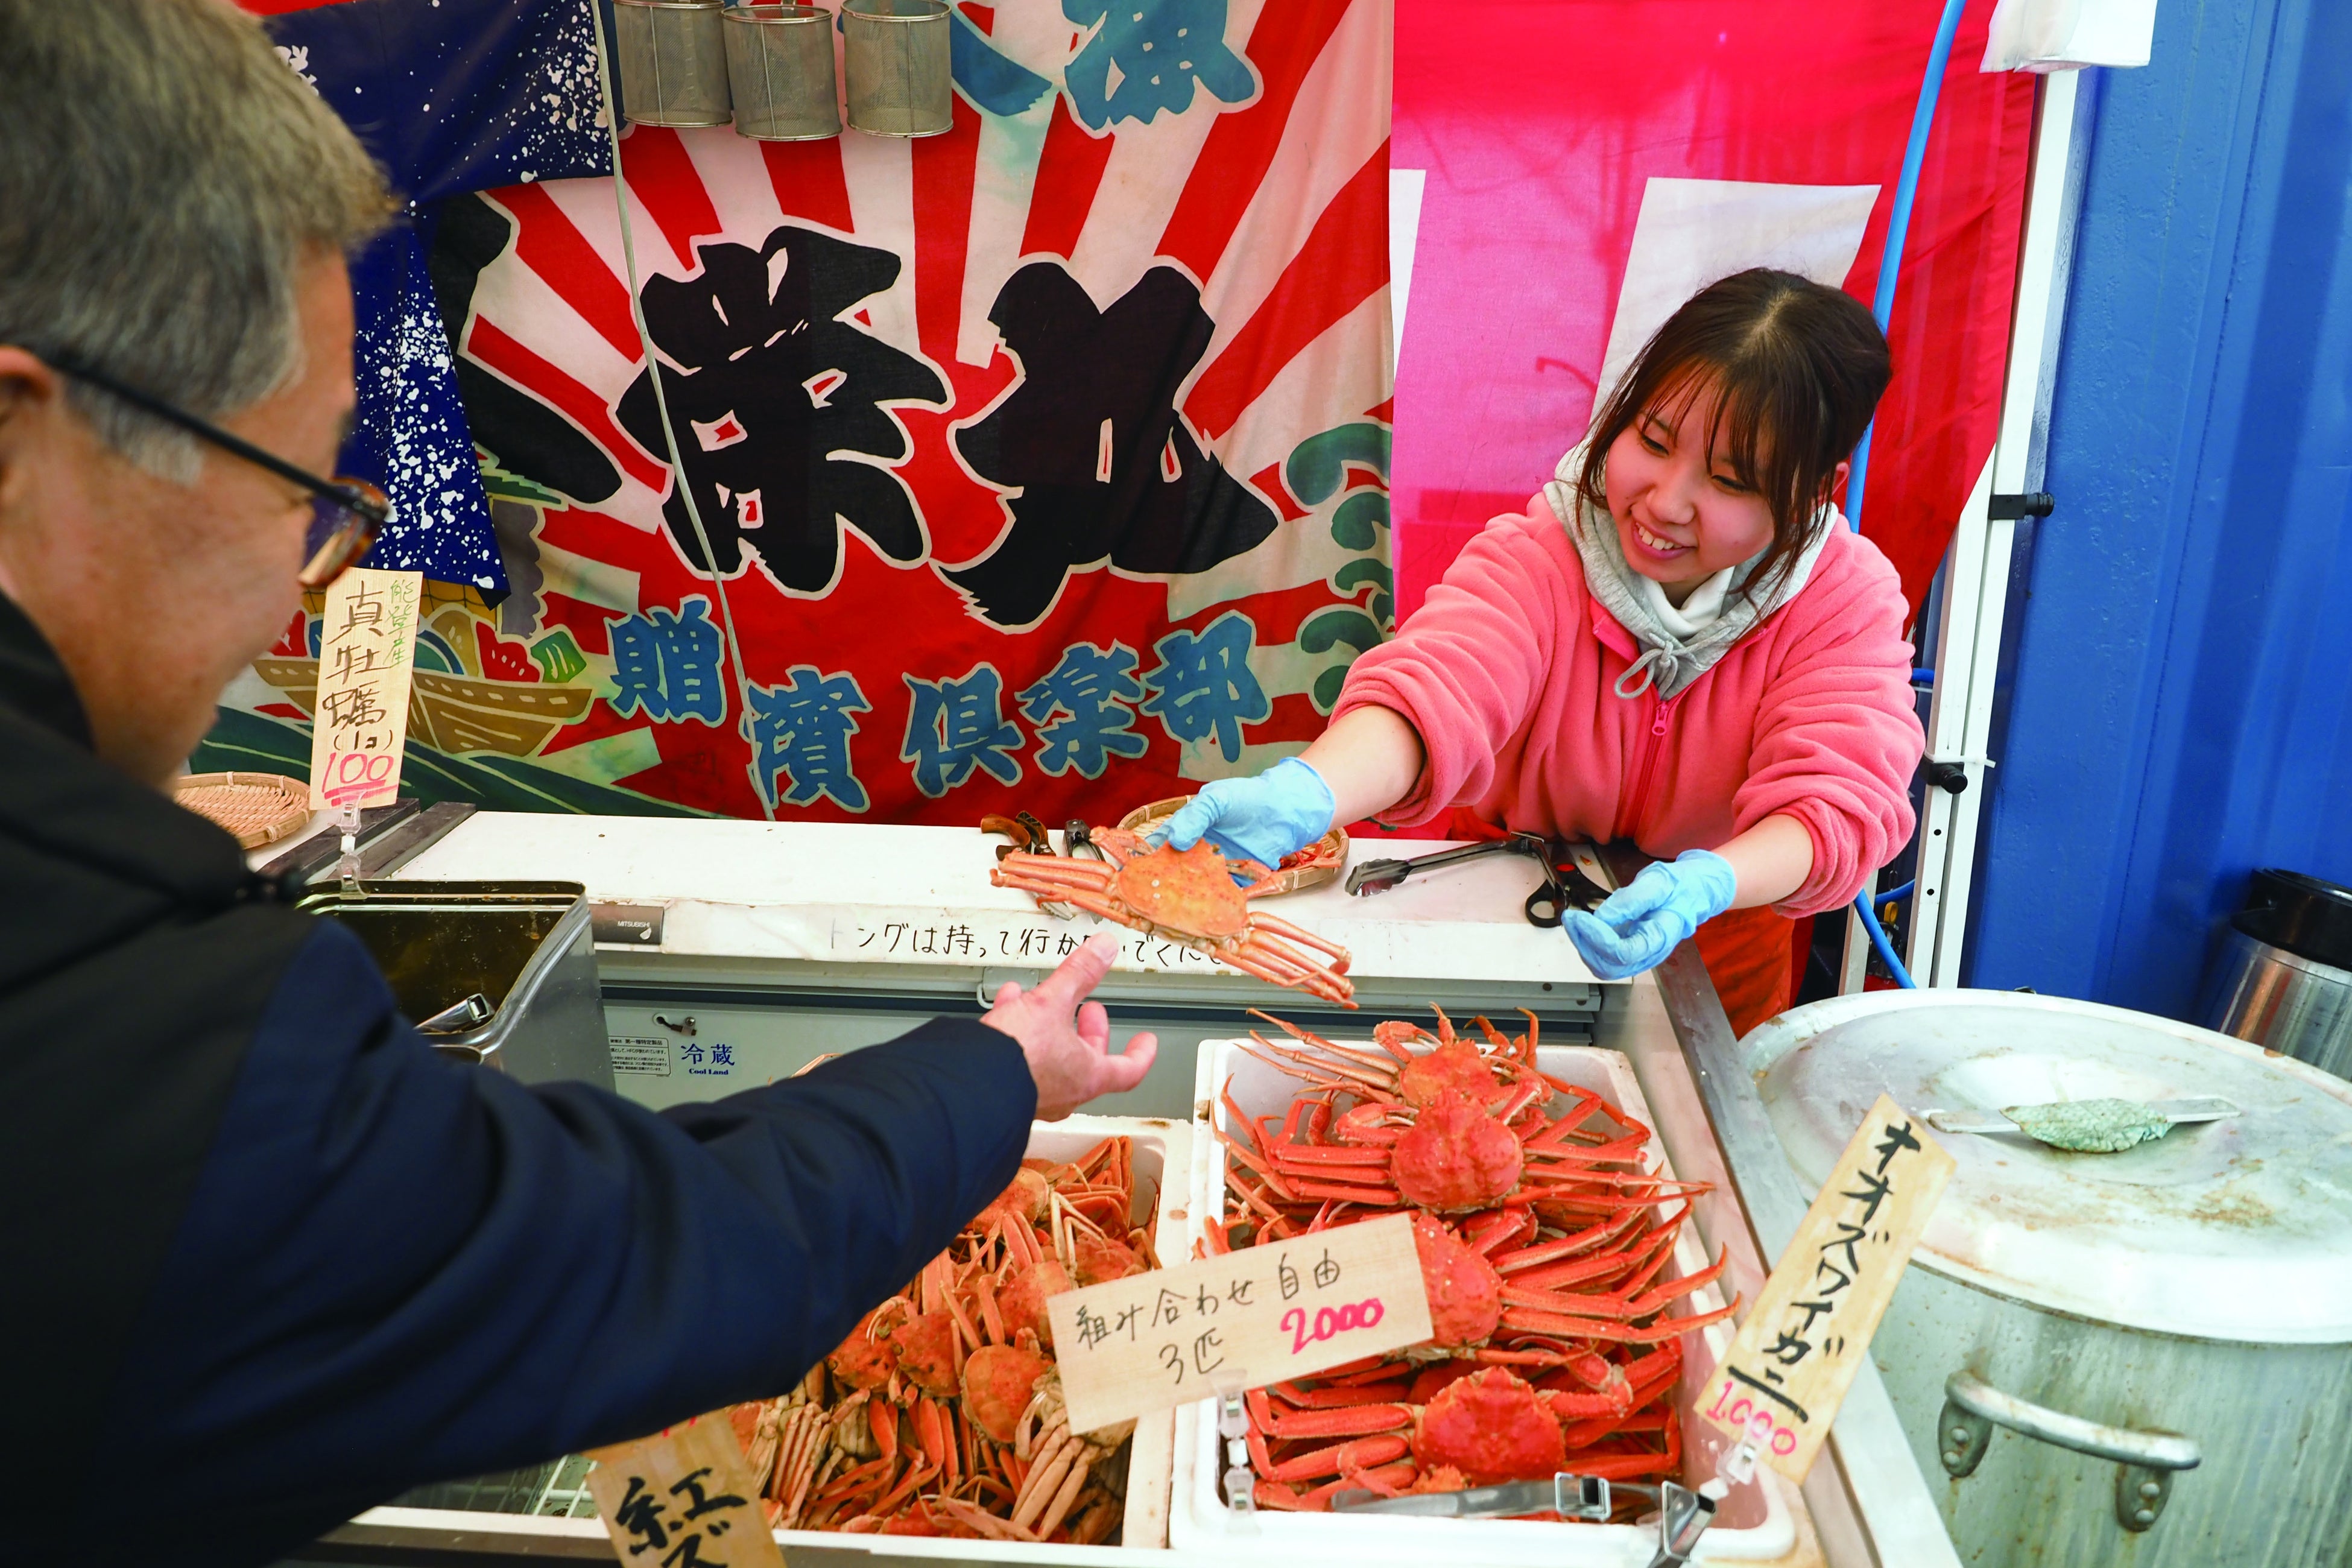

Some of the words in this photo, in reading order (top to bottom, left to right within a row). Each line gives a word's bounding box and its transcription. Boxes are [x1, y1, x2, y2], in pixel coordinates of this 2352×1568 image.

[384, 578, 420, 668] 能登産
[321, 752, 394, 794] 100
[681, 1043, 735, 1066] 冷蔵
[1727, 1121, 1922, 1424] オオズワイガニ
[1159, 1327, 1224, 1385] 3匹
[1280, 1297, 1385, 1355] 2000
